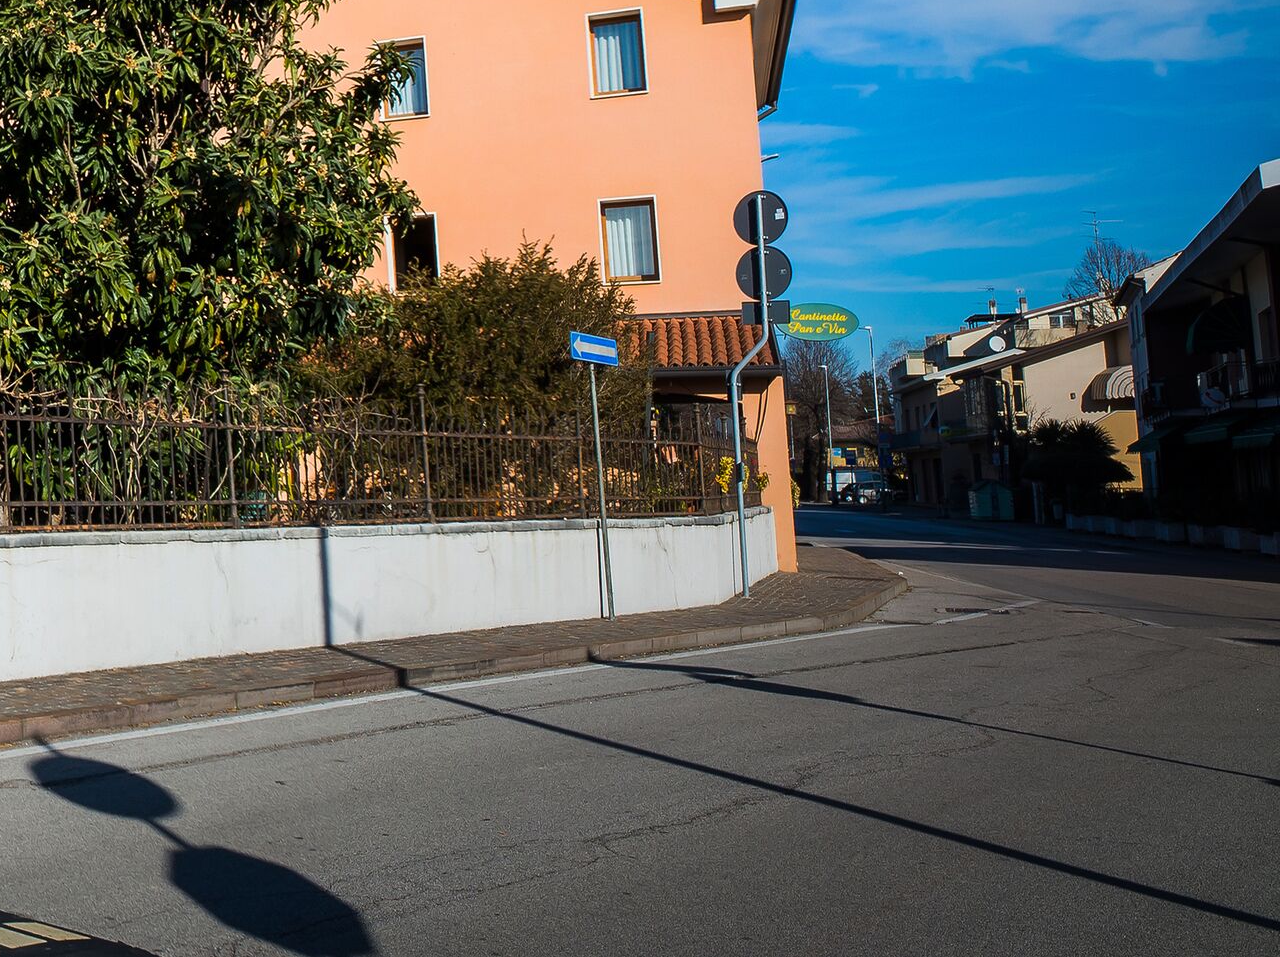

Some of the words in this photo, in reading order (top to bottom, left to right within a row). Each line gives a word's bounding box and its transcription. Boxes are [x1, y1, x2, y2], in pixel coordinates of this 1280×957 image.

[791, 309, 847, 322] Cantinetta
[788, 322, 814, 334] Pan
[822, 322, 847, 334] Vin
